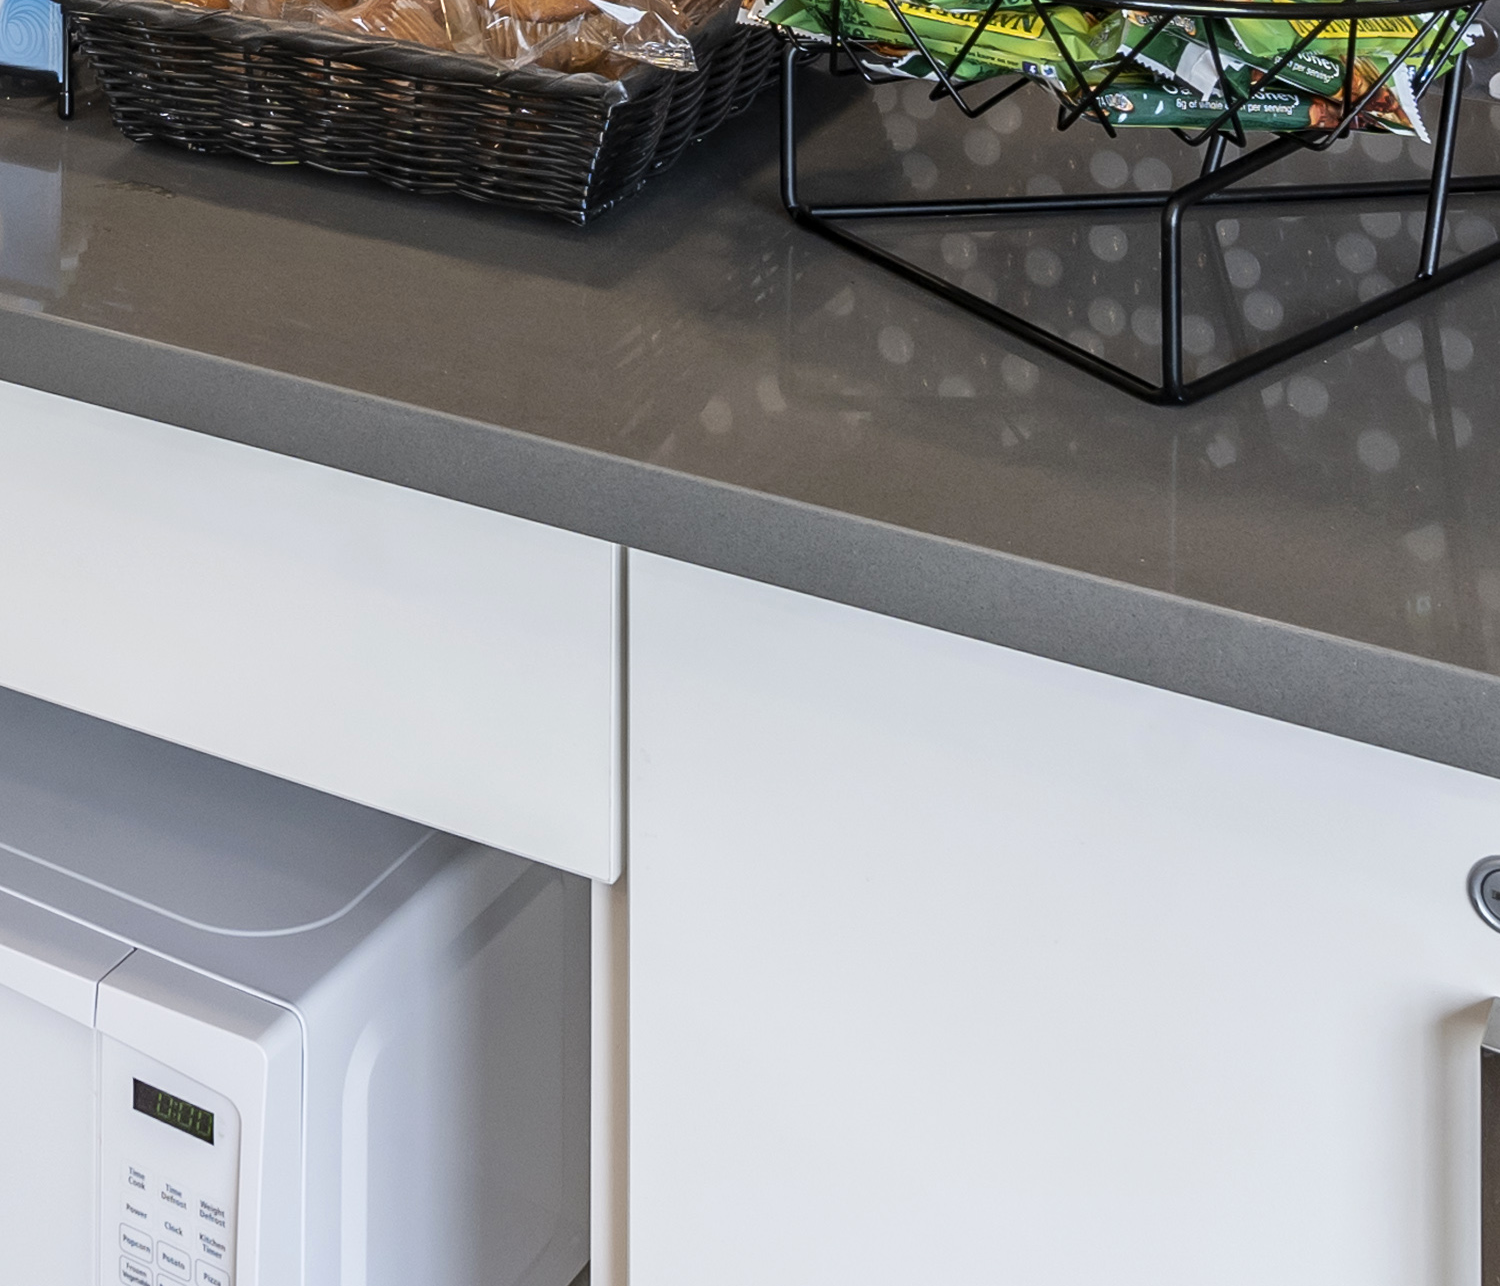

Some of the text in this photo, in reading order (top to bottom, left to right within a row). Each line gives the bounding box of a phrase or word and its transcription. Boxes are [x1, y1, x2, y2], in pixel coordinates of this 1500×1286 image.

[1292, 63, 1304, 74] per
[1297, 50, 1341, 78] oney
[1247, 103, 1261, 113] per
[157, 1092, 213, 1137] 0:00
[128, 1166, 146, 1180] Time
[128, 1175, 146, 1191] Cook
[165, 1183, 183, 1198] Time
[161, 1191, 188, 1210] Defrost
[126, 1203, 148, 1219] Power
[200, 1200, 226, 1219] Weight
[199, 1209, 227, 1229] Defrost
[164, 1221, 184, 1236] Clock
[122, 1234, 152, 1254] Popcorn
[199, 1232, 227, 1253] Kitchen
[202, 1244, 224, 1260] Timer
[162, 1252, 186, 1271] Potato
[126, 1262, 148, 1278] Frozen
[203, 1271, 223, 1286] Pizza
